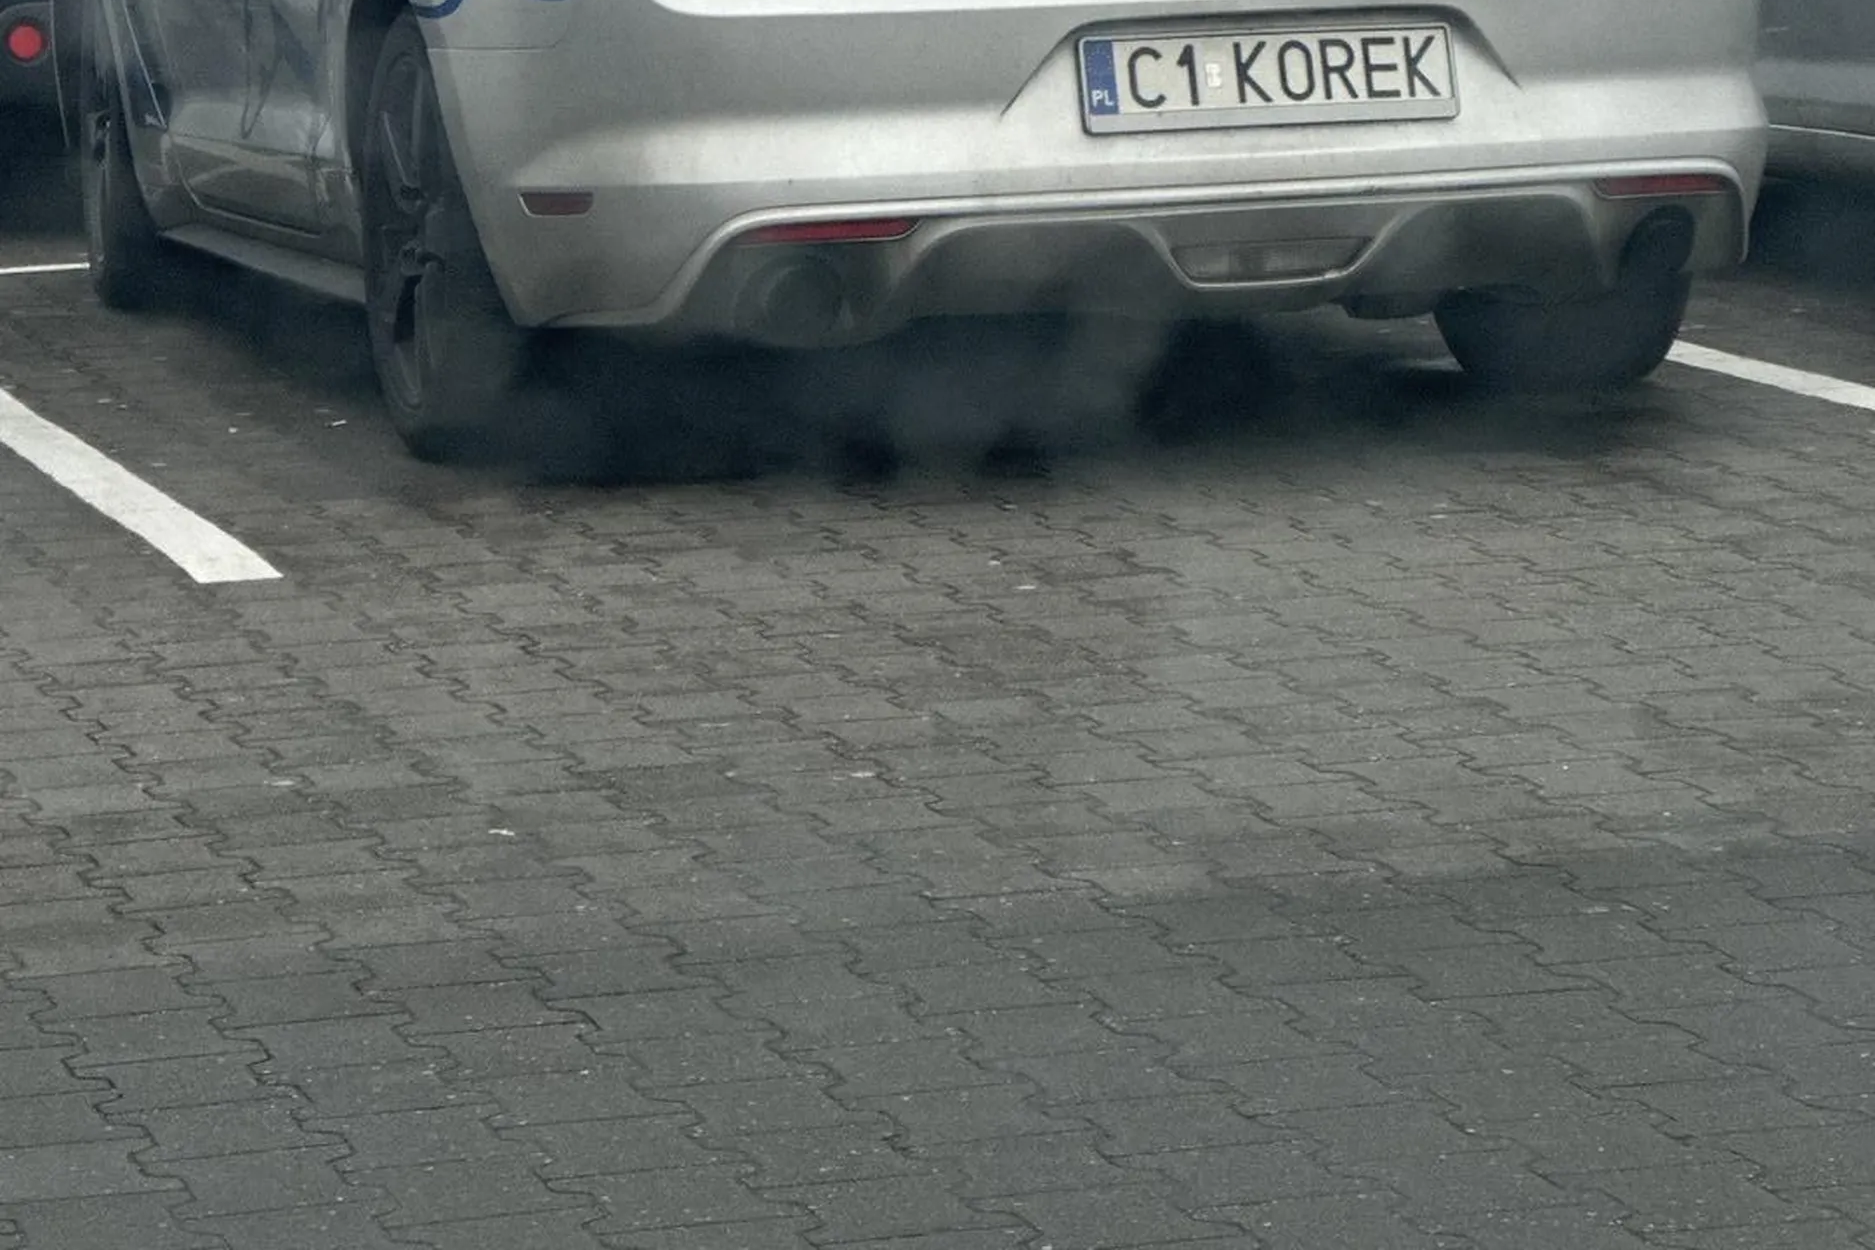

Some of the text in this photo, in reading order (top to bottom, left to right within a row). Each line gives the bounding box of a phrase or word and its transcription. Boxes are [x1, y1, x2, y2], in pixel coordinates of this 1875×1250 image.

[1127, 35, 1441, 108] C1 KOREK
[1091, 90, 1115, 107] PL
